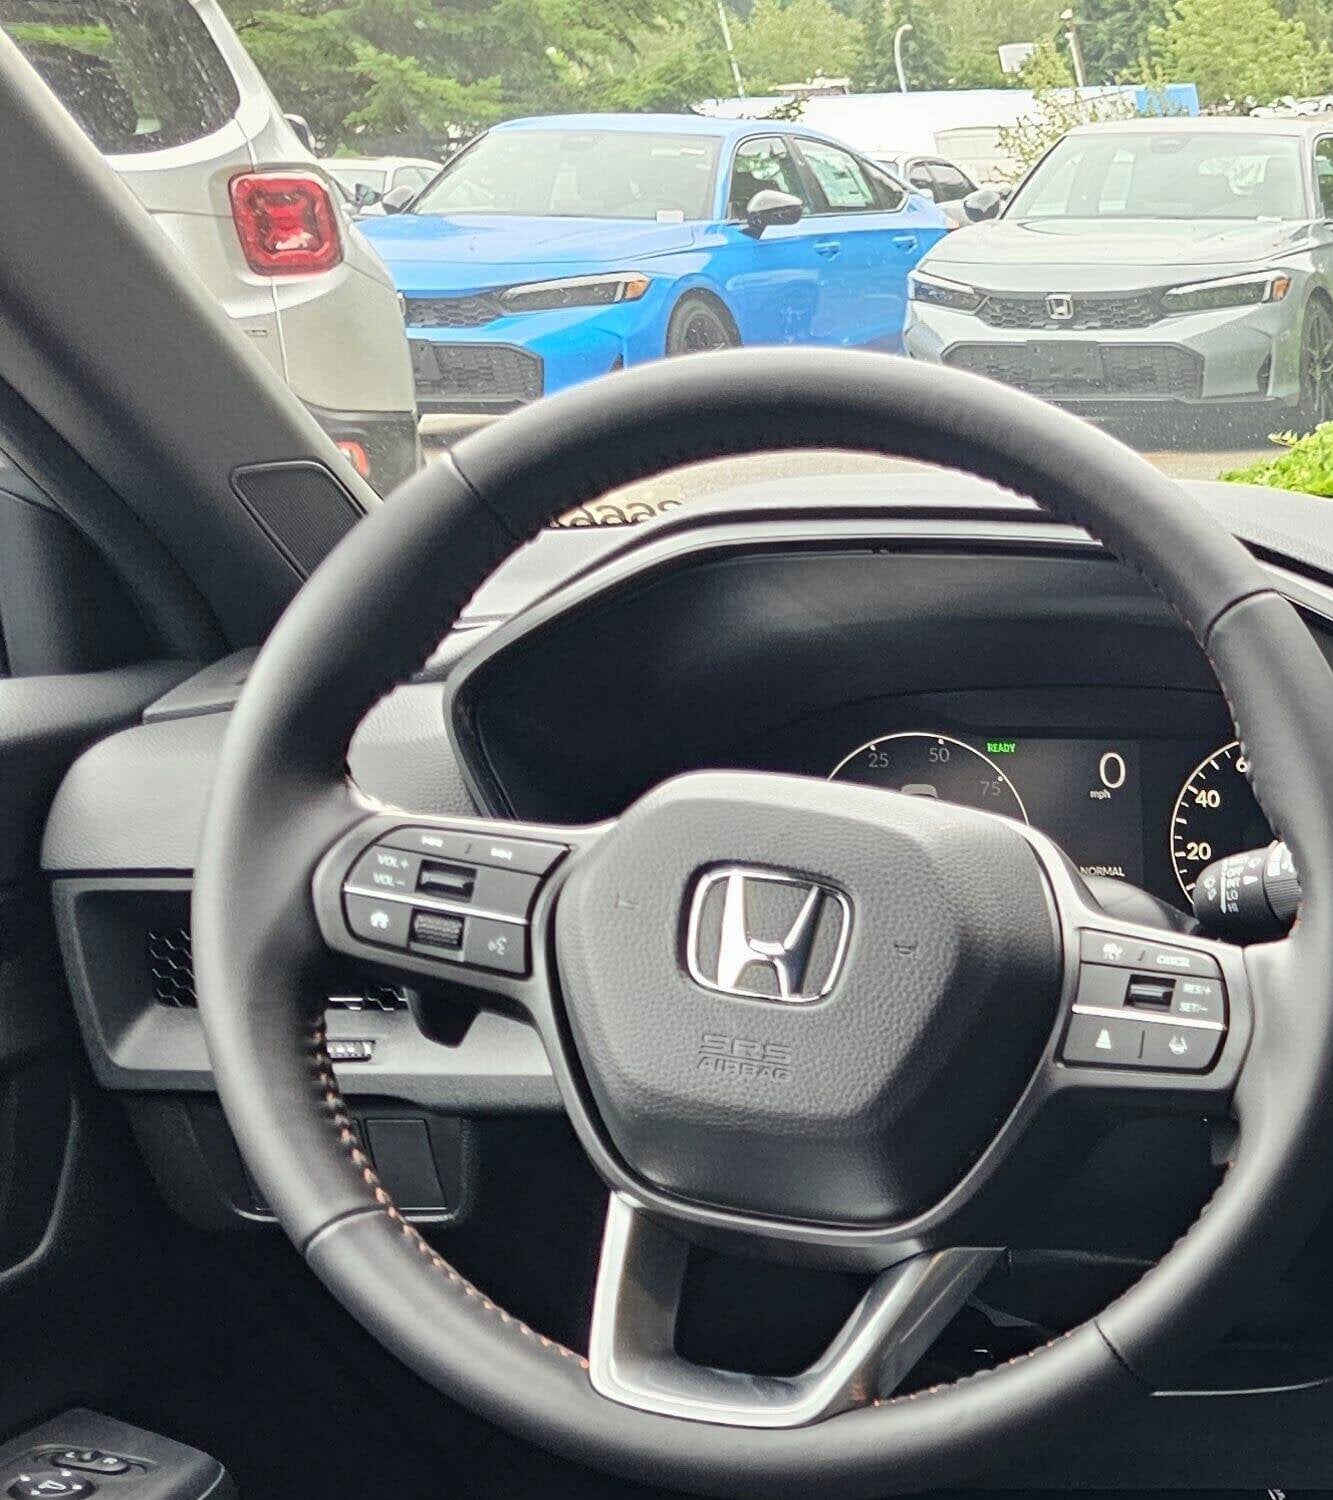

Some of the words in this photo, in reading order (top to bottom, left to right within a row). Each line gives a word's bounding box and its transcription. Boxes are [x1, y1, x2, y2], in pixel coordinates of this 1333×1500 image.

[928, 747, 951, 763] 50
[986, 743, 1016, 754] READY
[868, 753, 890, 768] 25
[1099, 752, 1127, 790] 0
[980, 781, 1000, 796] 75
[1090, 789, 1111, 800] mph
[1195, 788, 1220, 808] 40
[1186, 842, 1212, 861] 20
[1079, 866, 1126, 877] NORMAL
[1226, 889, 1239, 901] LO
[699, 1033, 791, 1061] SRS
[695, 1056, 793, 1080] AIRBAG
